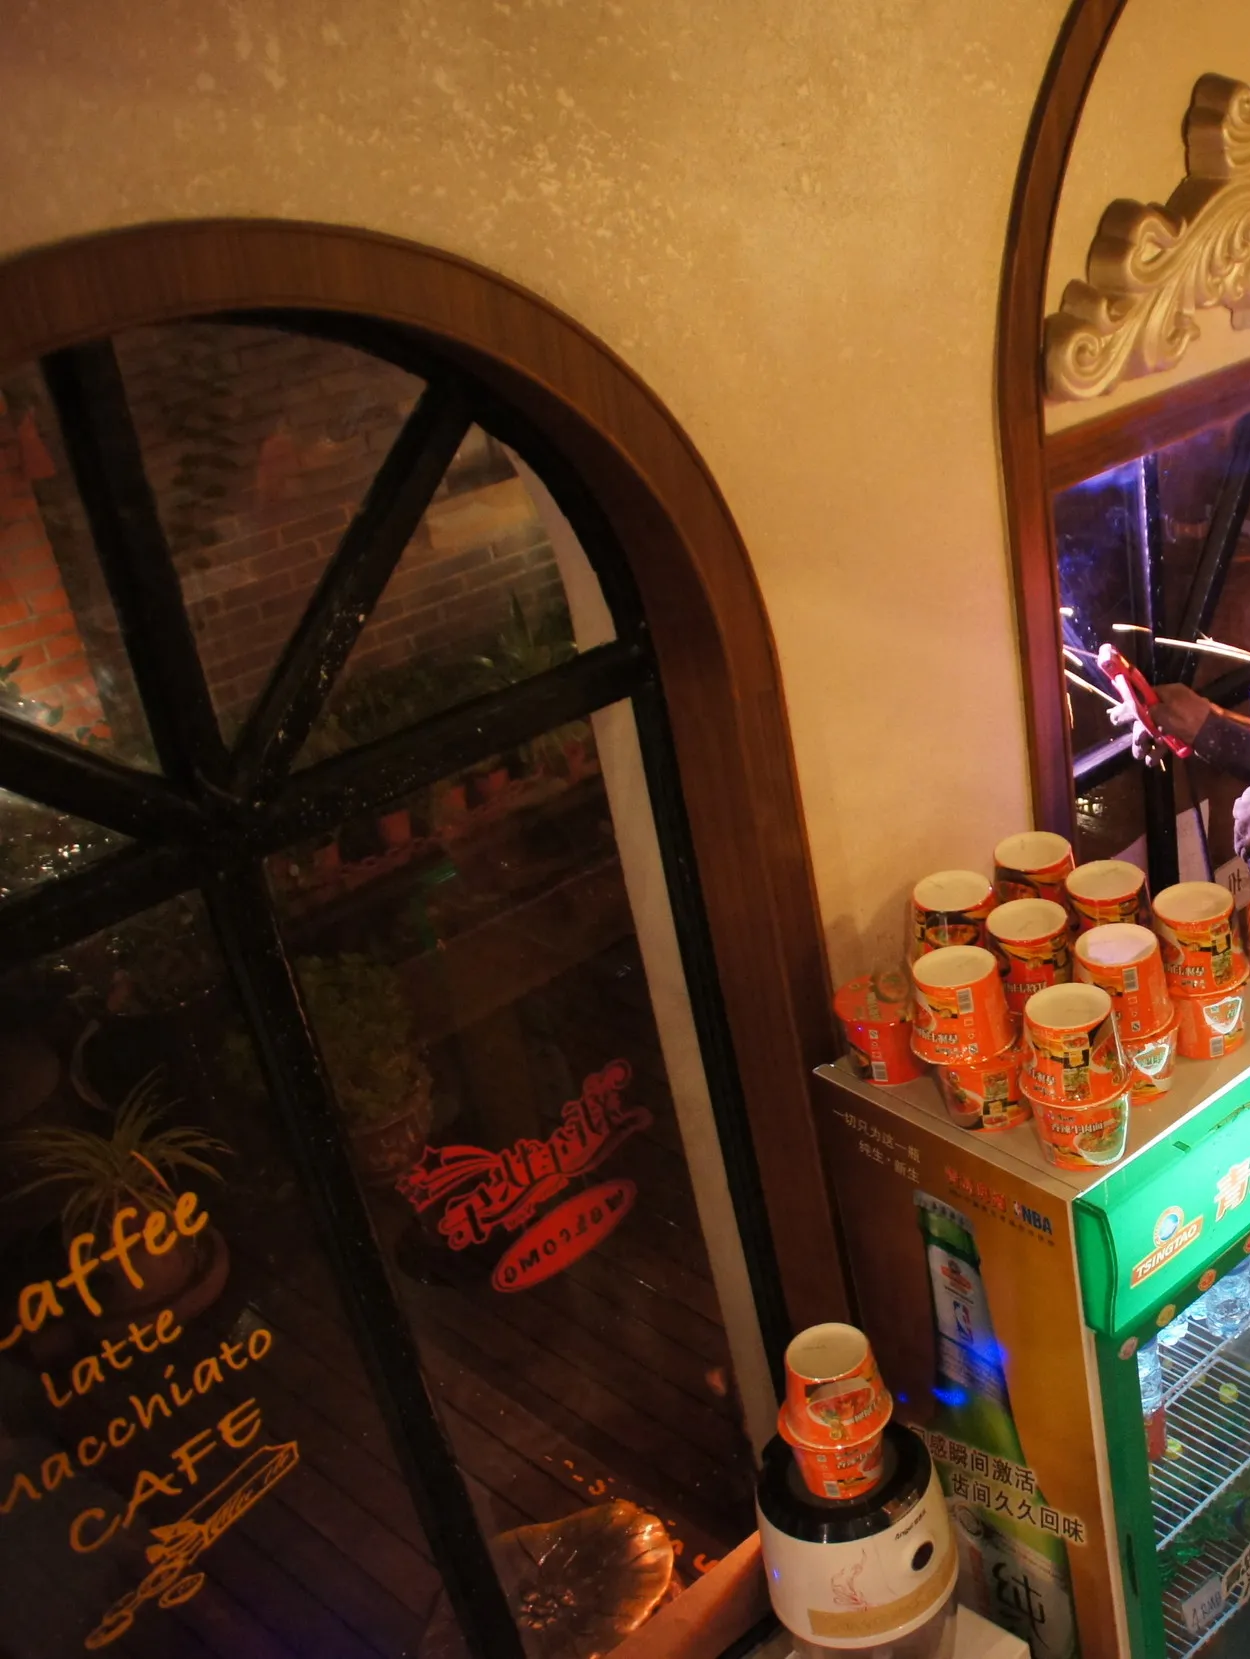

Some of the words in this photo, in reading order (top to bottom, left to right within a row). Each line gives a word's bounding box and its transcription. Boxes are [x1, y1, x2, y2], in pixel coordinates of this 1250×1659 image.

[832, 1108, 921, 1164] 一切只为这一瓶
[1021, 1203, 1053, 1236] NBA
[1134, 1223, 1199, 1279] TSINGTAO
[0, 1192, 208, 1350] affee
[69, 1397, 261, 1554] CAFE
[951, 1472, 1085, 1545] 齿间久久回味
